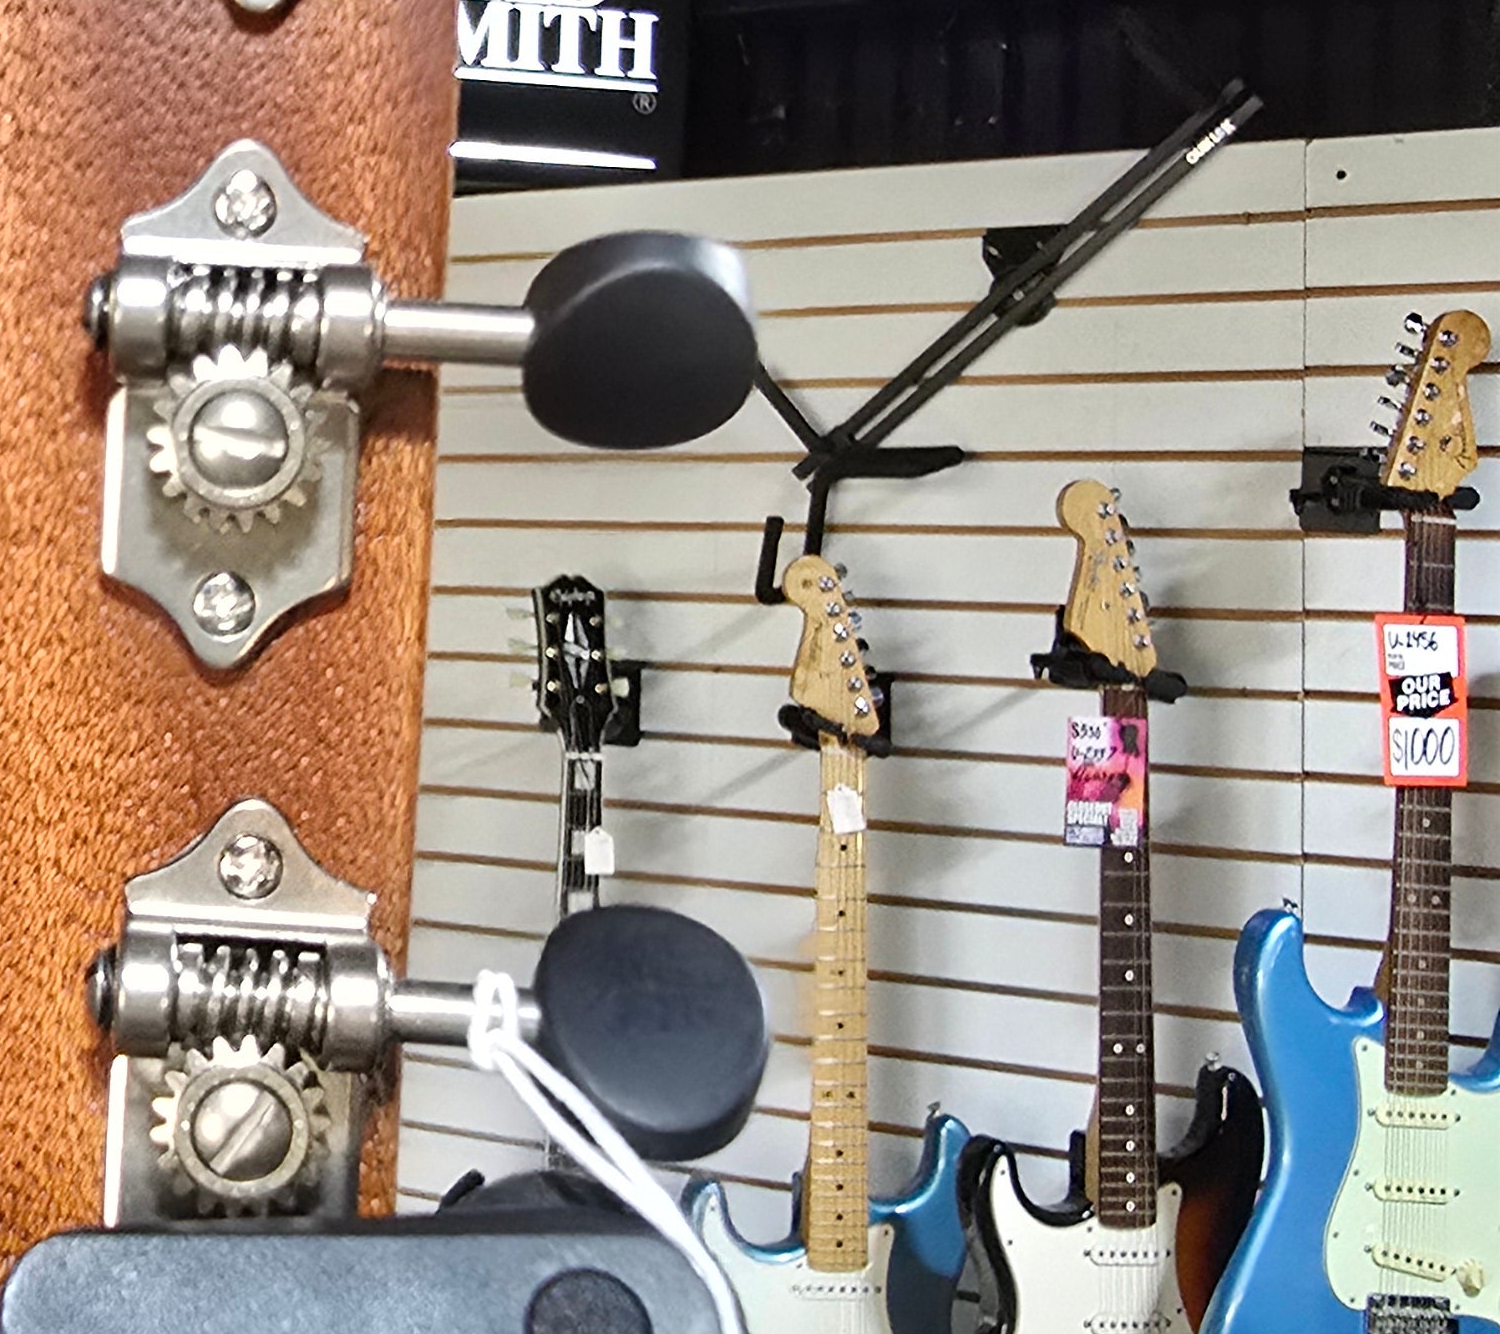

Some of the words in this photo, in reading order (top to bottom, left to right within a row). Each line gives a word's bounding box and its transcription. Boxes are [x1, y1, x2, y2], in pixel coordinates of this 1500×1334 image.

[457, 1, 660, 80] MITH
[1396, 688, 1451, 712] PRICE
[1401, 674, 1442, 695] OUR
[1391, 726, 1456, 771] $1000
